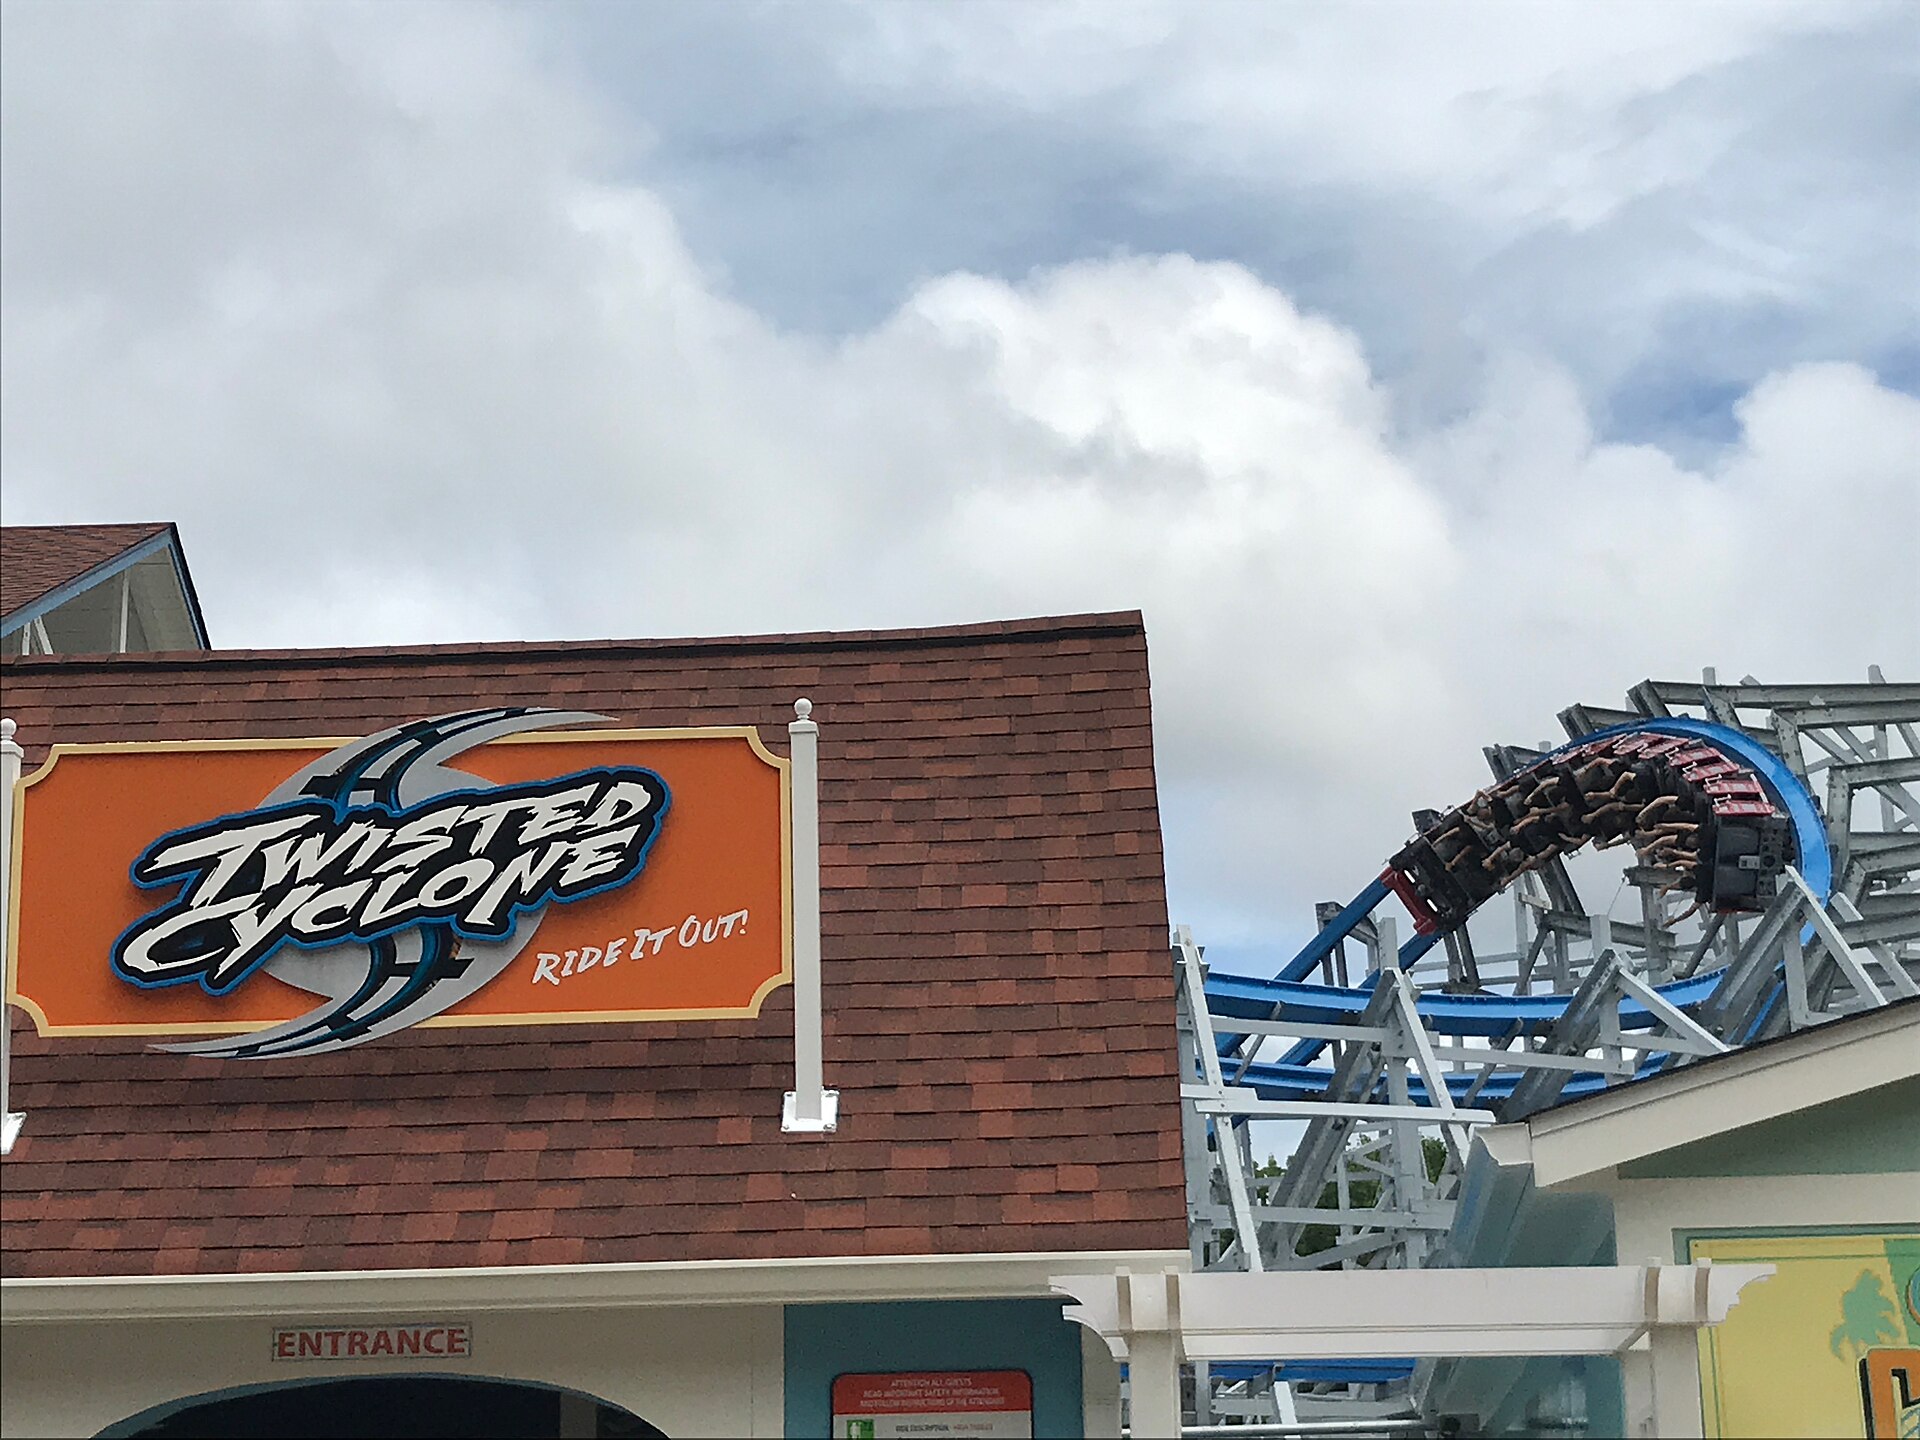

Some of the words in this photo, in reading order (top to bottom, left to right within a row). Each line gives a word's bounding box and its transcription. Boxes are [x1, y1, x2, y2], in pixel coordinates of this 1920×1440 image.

[142, 782, 651, 908] TWISTED
[123, 824, 641, 980] CYCLONE
[531, 937, 628, 986] RIDE
[629, 928, 676, 960] IT
[678, 909, 748, 948] OUT!
[277, 1328, 466, 1358] ENTRANCE
